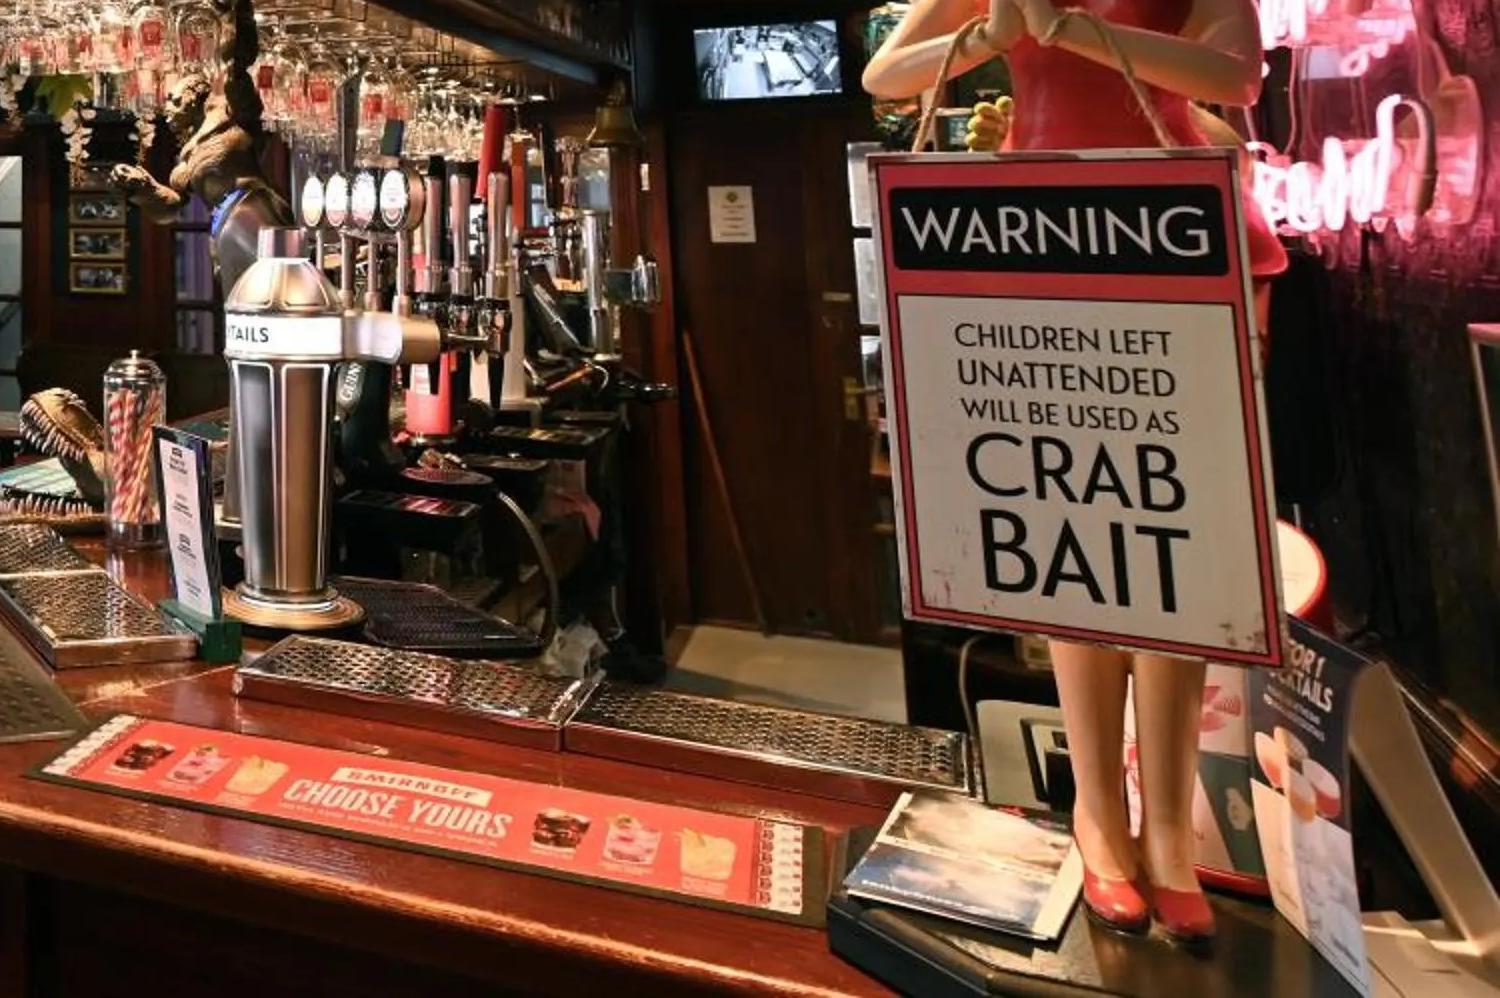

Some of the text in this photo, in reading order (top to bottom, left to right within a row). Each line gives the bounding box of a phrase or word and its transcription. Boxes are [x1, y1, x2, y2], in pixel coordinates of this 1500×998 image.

[901, 205, 1211, 257] WARNING
[228, 325, 269, 343] TAILS
[955, 322, 1172, 356] CHILDREN LEFT
[340, 363, 361, 402] GUIN
[957, 359, 1176, 397] UNATTENDED
[961, 397, 1180, 435] WILL BE USED AS
[965, 432, 1187, 513] CRAB
[980, 508, 1190, 613] BAIT
[1286, 638, 1316, 675] OR
[282, 778, 403, 819] CHOOSE
[407, 798, 513, 839] YOURS
